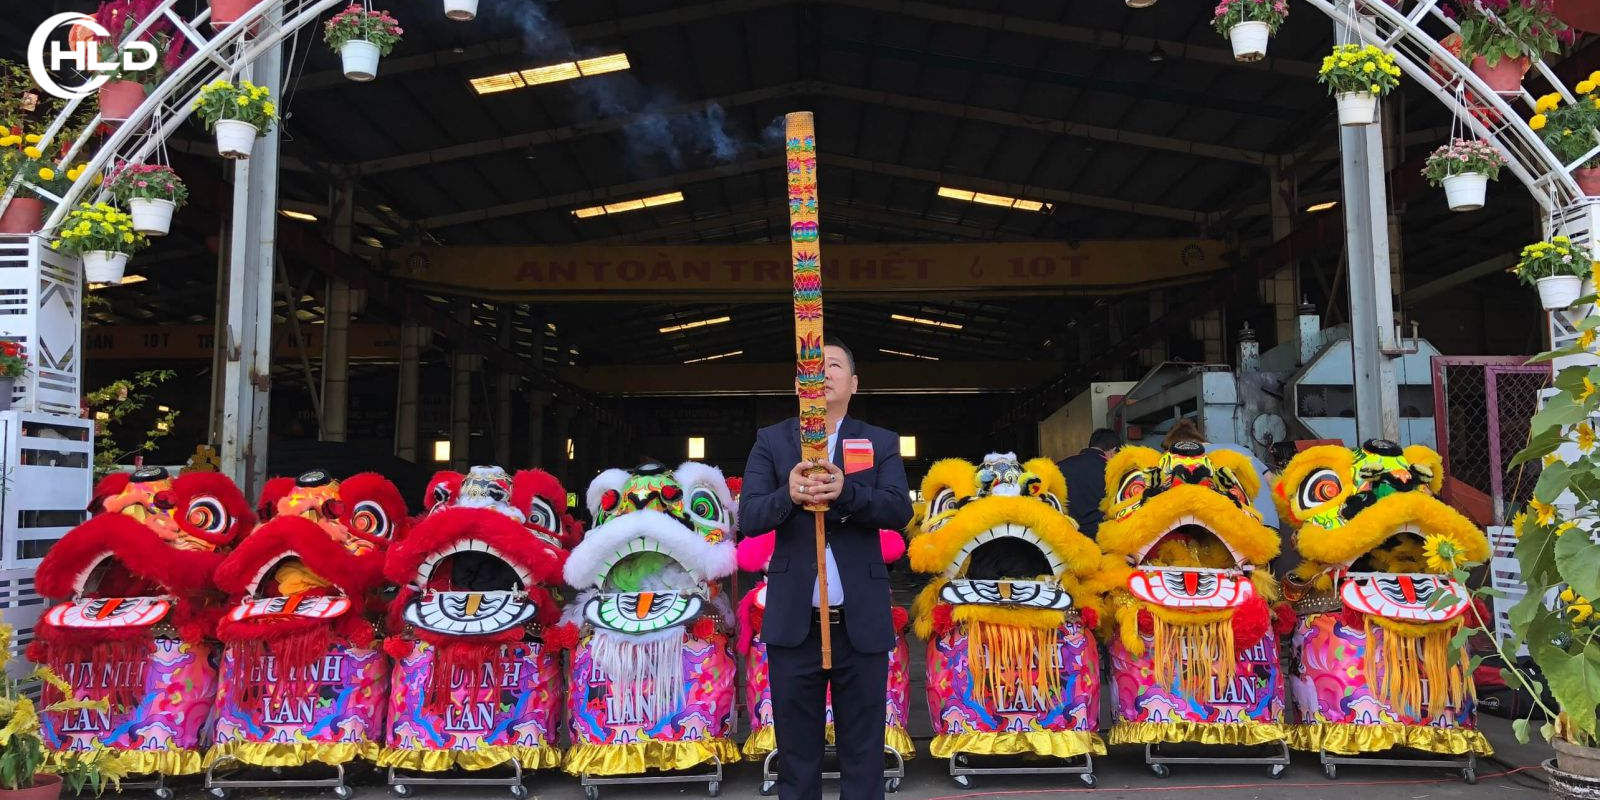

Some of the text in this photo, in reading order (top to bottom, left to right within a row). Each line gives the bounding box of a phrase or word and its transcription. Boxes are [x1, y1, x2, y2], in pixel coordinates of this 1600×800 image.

[515, 260, 577, 282] AN
[585, 252, 712, 282] TOÀN
[722, 258, 840, 282] TRN
